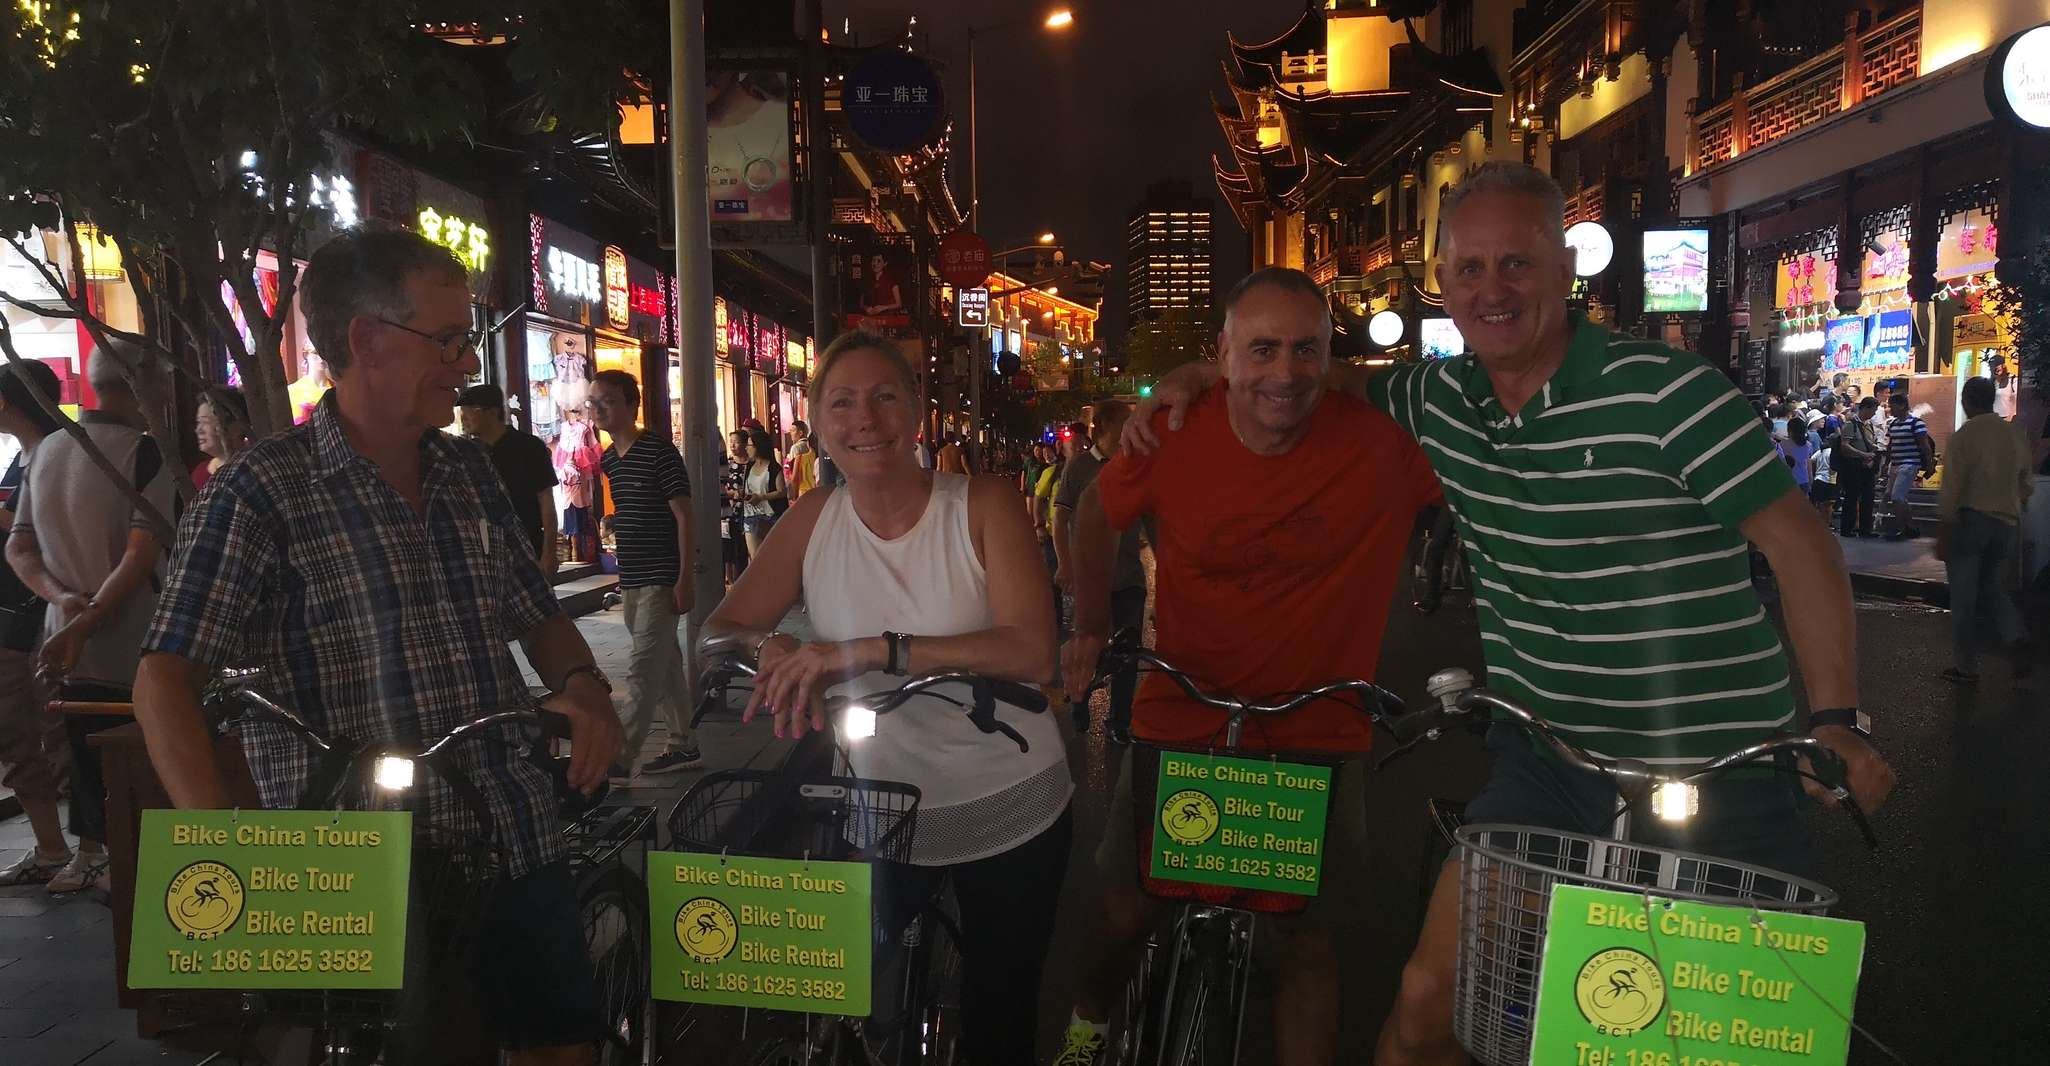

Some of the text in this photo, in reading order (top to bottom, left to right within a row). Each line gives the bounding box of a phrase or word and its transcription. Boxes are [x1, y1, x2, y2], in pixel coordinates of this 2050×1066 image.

[856, 85, 928, 103] 亚一珠宝
[1166, 760, 1328, 791] Bike China Tours
[1224, 797, 1304, 822] Bike Tour
[173, 824, 382, 847] Bike China Tours
[1221, 829, 1318, 855] Bike Rental
[675, 865, 847, 893] Bike China Tours
[1162, 850, 1316, 882] Tel: 186 1625 3582
[250, 867, 354, 892] Bike Tour
[246, 910, 374, 936] Bike Rental
[741, 904, 826, 931] Bike Tour
[1586, 902, 1830, 956] Bike China Tours
[186, 930, 219, 942] BCT
[168, 949, 373, 973] Tel: 186 1625 3582
[741, 941, 845, 969] Bike Rental
[681, 970, 846, 1000] Tel: 186 1625 3582
[1672, 961, 1794, 1002] Bike Tour
[1597, 1024, 1635, 1039] BCT
[1665, 1010, 1814, 1055] Bike Rental
[1575, 1042, 1614, 1066] Tel:
